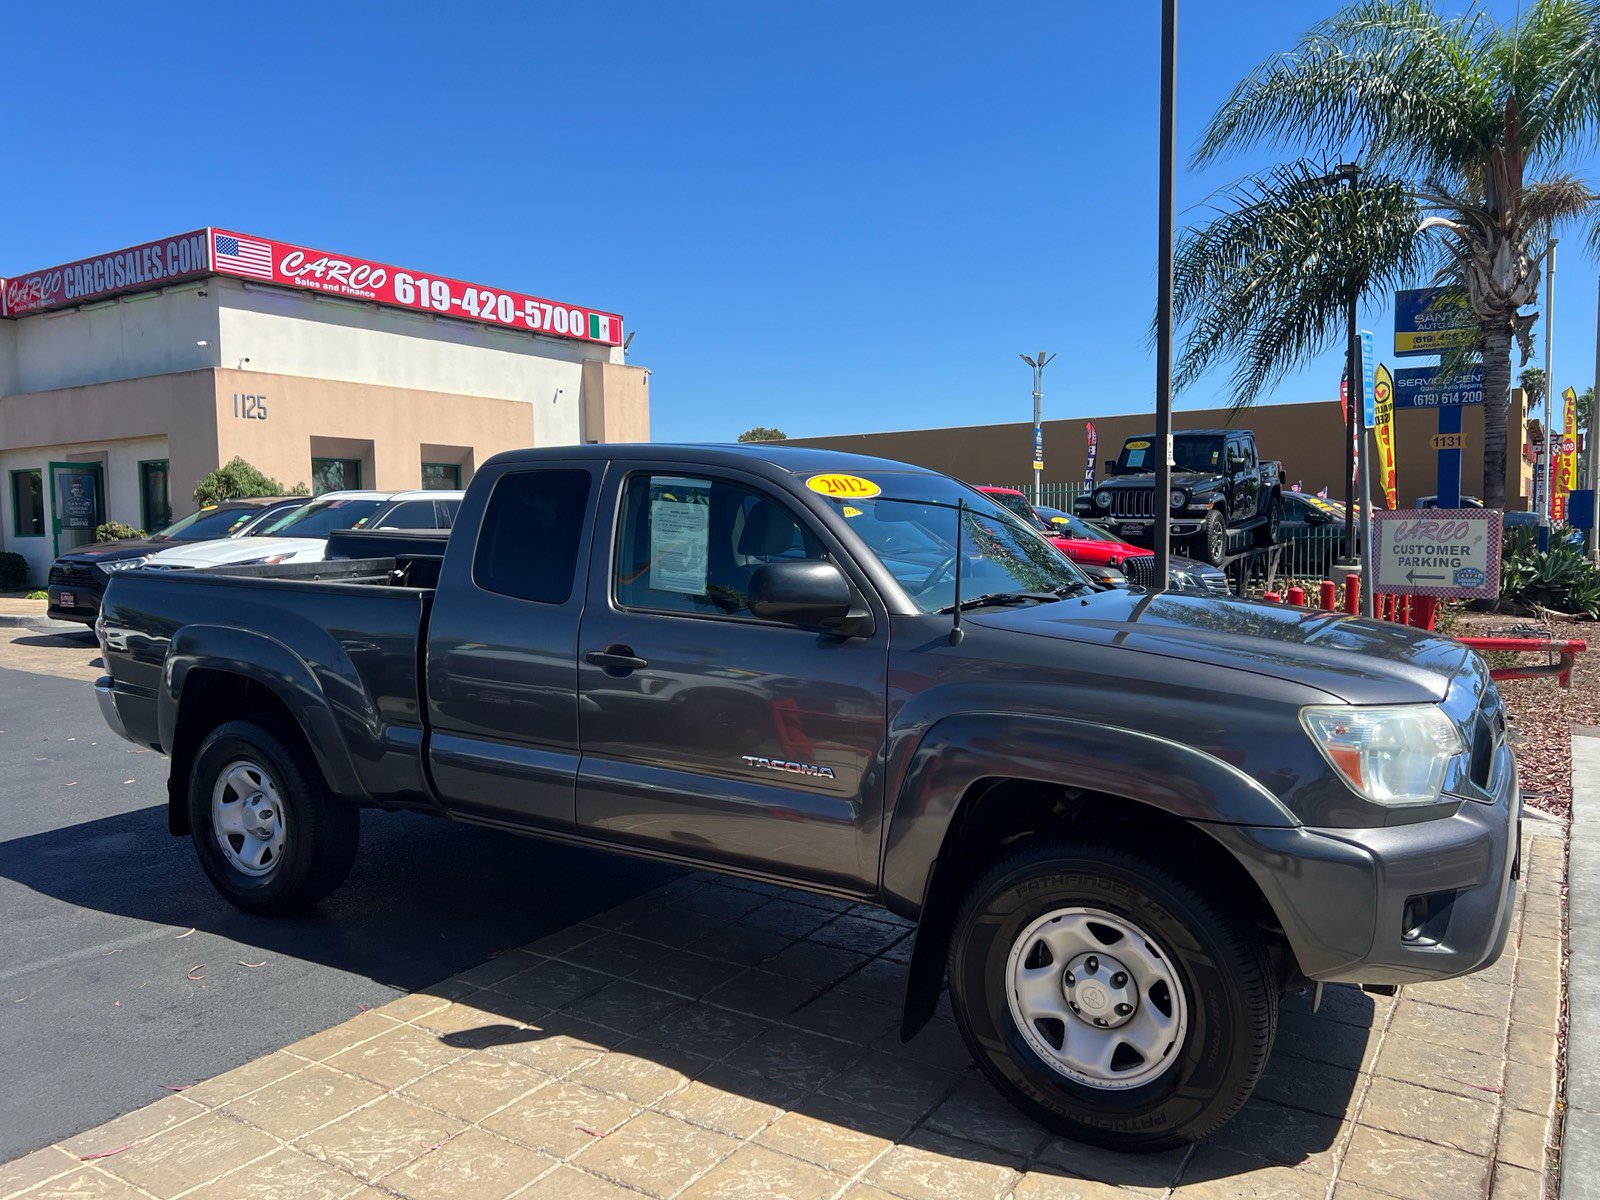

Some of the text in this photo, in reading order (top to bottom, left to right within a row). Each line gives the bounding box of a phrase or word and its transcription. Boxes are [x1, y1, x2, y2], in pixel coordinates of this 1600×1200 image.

[63, 234, 207, 300] CARCOSALES.COM
[280, 250, 388, 290] CARCO
[7, 270, 62, 308] CARCO
[294, 277, 376, 299] Sales and Finance
[393, 272, 586, 337] 619-420-5700
[1417, 322, 1445, 331] AUTO
[1413, 335, 1436, 344] (619)
[1454, 374, 1483, 384] CEN
[1459, 382, 1483, 391] Repairs
[233, 393, 268, 420] 1125
[1413, 391, 1484, 406] (619) 614 200
[1433, 436, 1461, 447] 1131
[820, 478, 867, 493] 2012
[1393, 520, 1469, 544] CARCO
[1392, 545, 1471, 556] CUSTOMER
[1397, 557, 1462, 568] PARKING
[741, 755, 836, 779] TACOMA
[1014, 873, 1141, 903] PATHFINDER
